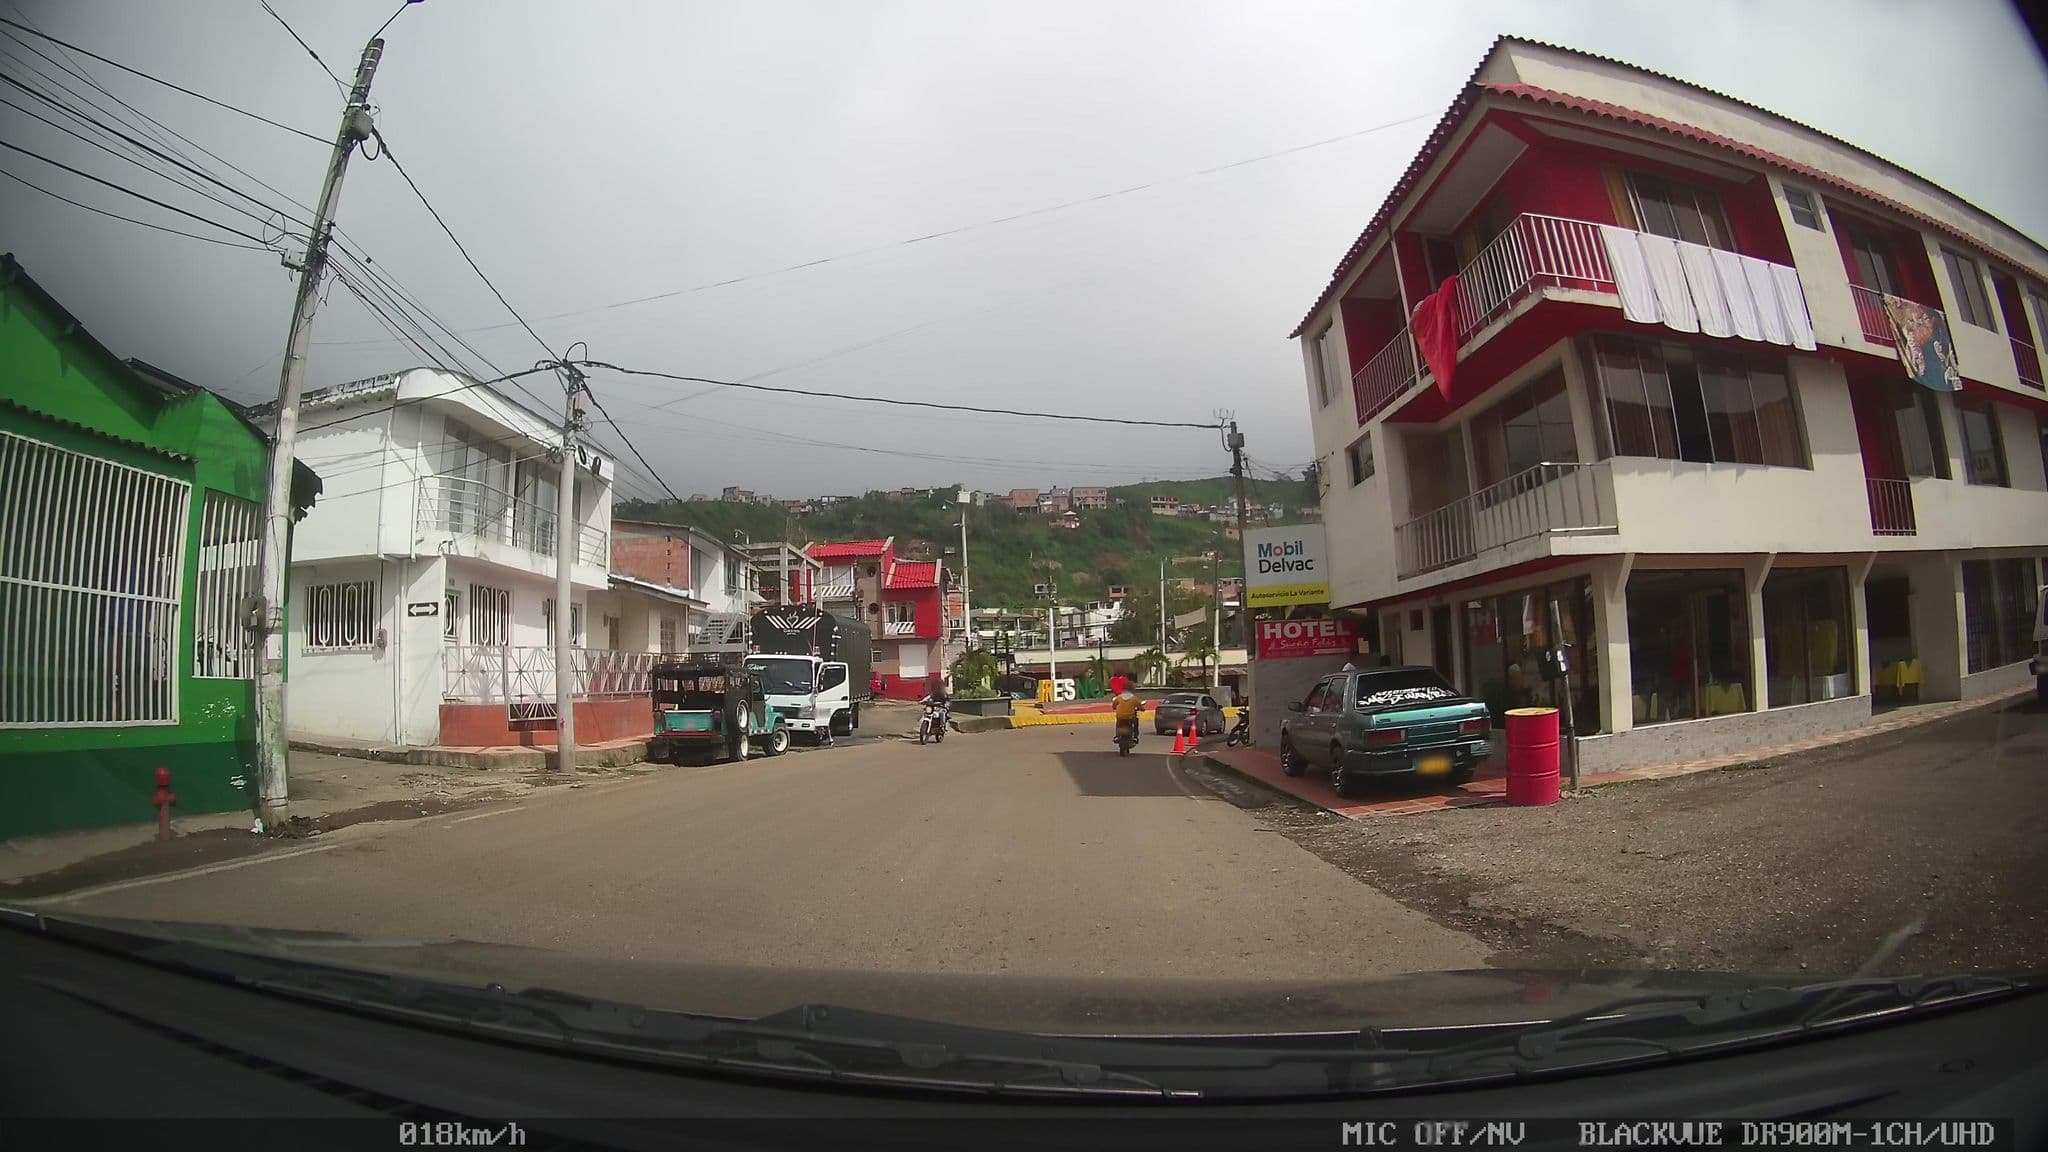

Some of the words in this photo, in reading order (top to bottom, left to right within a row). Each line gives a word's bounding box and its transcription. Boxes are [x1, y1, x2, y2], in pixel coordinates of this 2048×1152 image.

[1258, 540, 1303, 557] Mobil
[1259, 558, 1314, 573] Delvac
[1263, 621, 1350, 639] HOTEL
